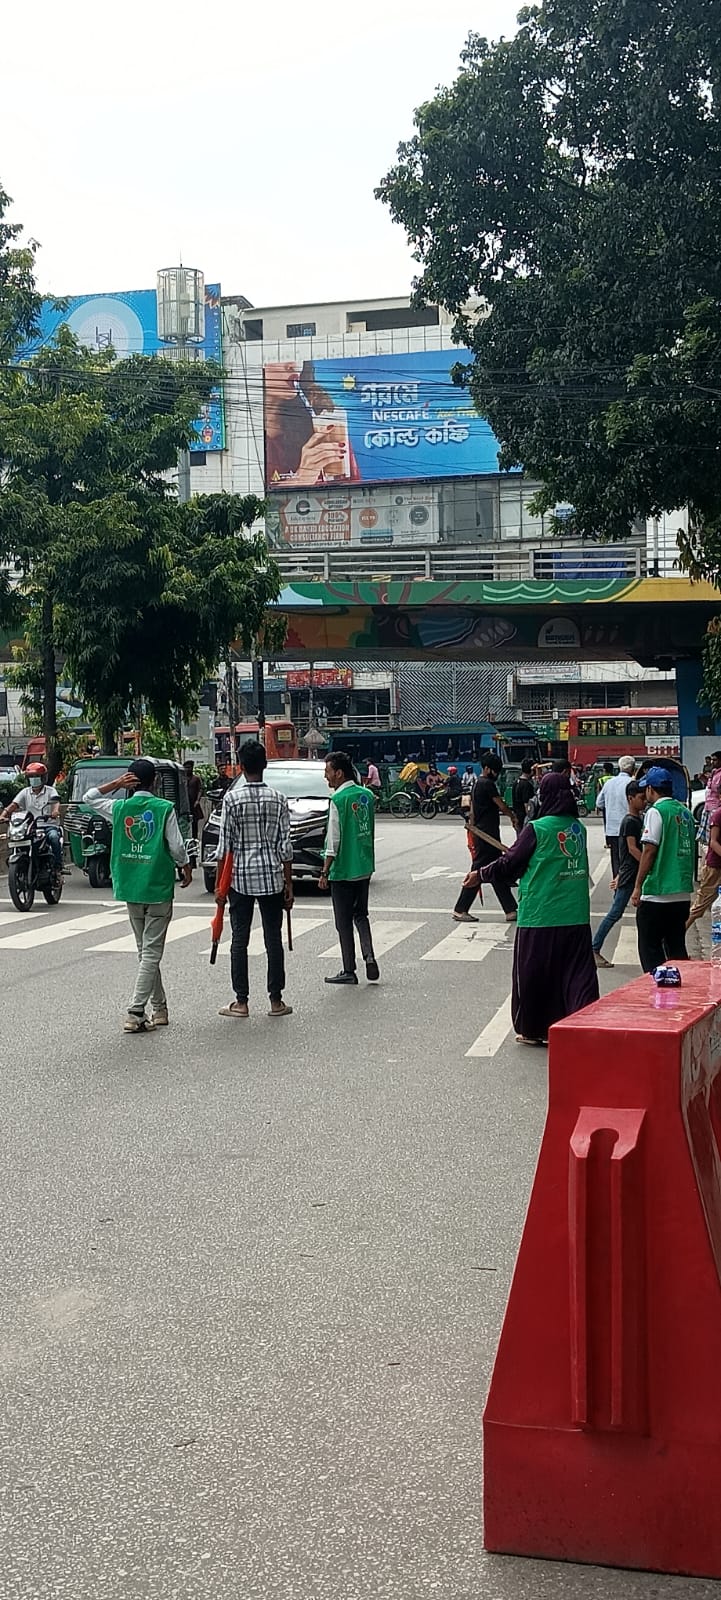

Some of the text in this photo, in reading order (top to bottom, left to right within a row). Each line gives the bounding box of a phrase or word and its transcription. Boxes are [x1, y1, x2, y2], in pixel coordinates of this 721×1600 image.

[364, 419, 471, 448] কোল্ড কফি
[131, 843, 145, 853] blf
